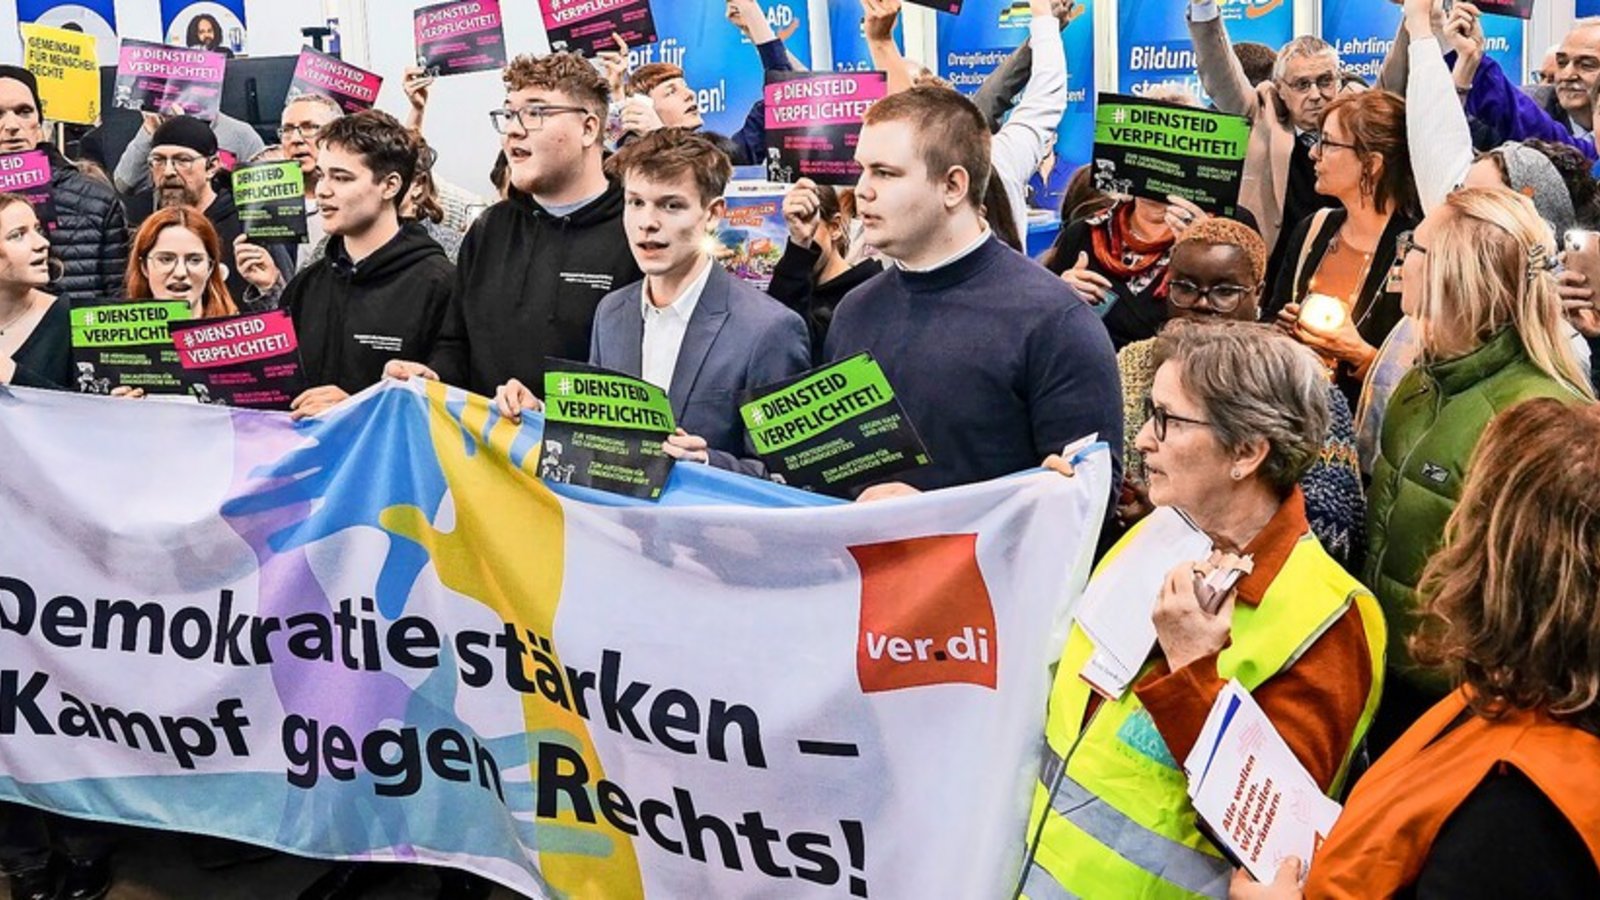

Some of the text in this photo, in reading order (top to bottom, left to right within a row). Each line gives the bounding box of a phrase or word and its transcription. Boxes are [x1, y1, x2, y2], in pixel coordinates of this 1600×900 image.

[421, 14, 496, 38] VERPFLICHTET!
[767, 4, 793, 26] AfD
[28, 37, 80, 55] GEMEINSAM
[628, 45, 653, 75] eit
[660, 38, 686, 67] für
[1485, 36, 1510, 52] nn,
[29, 64, 65, 79] RECHTE
[50, 53, 96, 70] MENSCHEN
[128, 62, 218, 79] VERPFLICHTET!
[773, 79, 857, 104] #DIENSTEID
[1112, 107, 1218, 133] #DIENSTEID
[1109, 127, 1238, 156] VERPFLICHTET!
[1, 156, 24, 171] EID
[85, 307, 169, 326] #DIENSTEID
[83, 326, 169, 343] VERPFLICHT
[184, 319, 265, 348] #DIENSTEID
[187, 333, 290, 362] VERPFLICHTET!
[558, 377, 649, 402] #DIENSTEID
[751, 373, 847, 425] #DIENSTEID
[758, 383, 885, 448] VERPFLICHTET!
[866, 626, 989, 663] ver.di
[0, 576, 440, 671] Demokratie
[455, 622, 767, 768] stärken
[0, 669, 868, 899] Kampf gegen Rechts!
[1223, 755, 1255, 832] Alle wollen
[1232, 783, 1259, 842] regieren.
[1240, 778, 1273, 851] Wir wollen
[1250, 792, 1282, 863] verändern.
